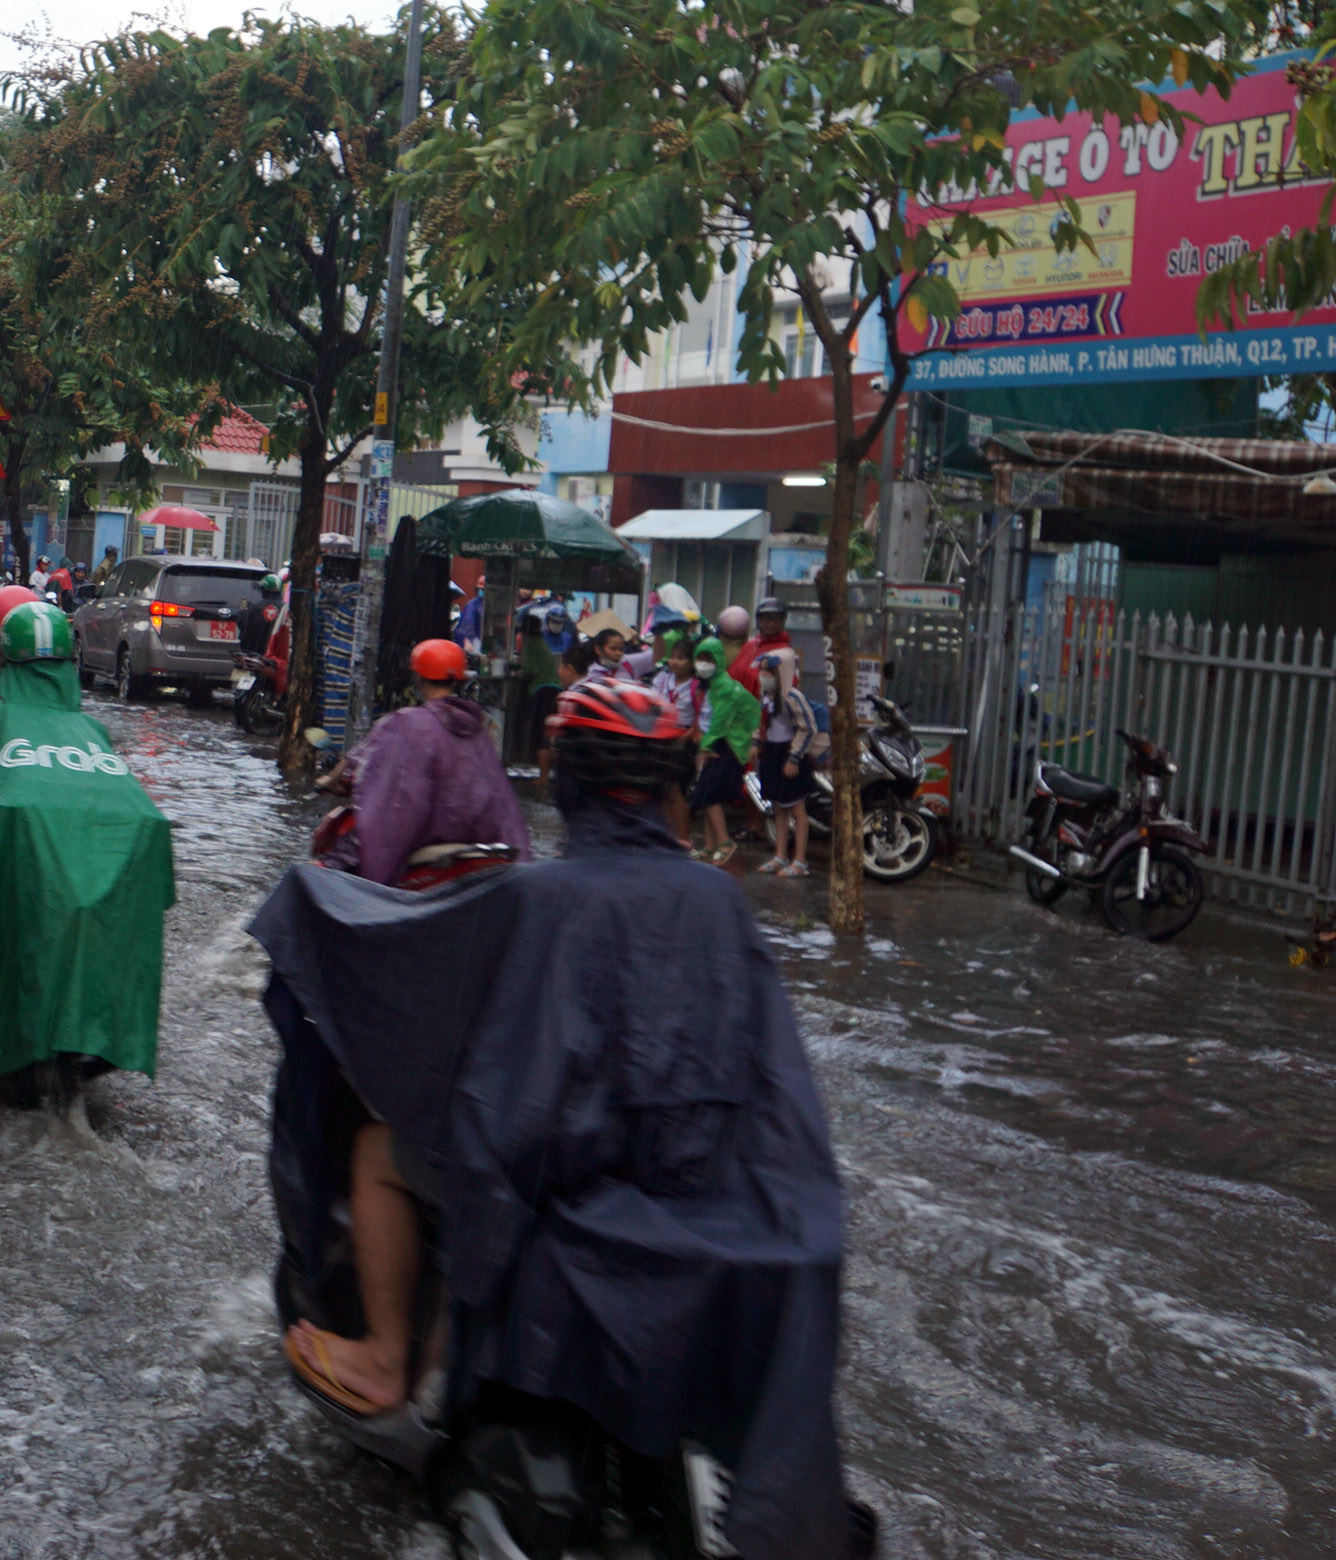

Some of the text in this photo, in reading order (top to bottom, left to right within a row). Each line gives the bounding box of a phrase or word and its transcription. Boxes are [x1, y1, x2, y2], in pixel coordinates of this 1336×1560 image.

[1167, 237, 1201, 278] SỬA
[954, 303, 1091, 339] CỨU HỘ 24/24
[915, 360, 936, 381] 37,
[988, 354, 1026, 376] SONG
[1028, 348, 1074, 375] HÀNH,
[1077, 351, 1093, 372] P.
[1096, 345, 1128, 370] TÂN
[1179, 336, 1242, 369] THUẬN,
[1247, 338, 1288, 365] Q12,
[1292, 335, 1322, 360] TP.
